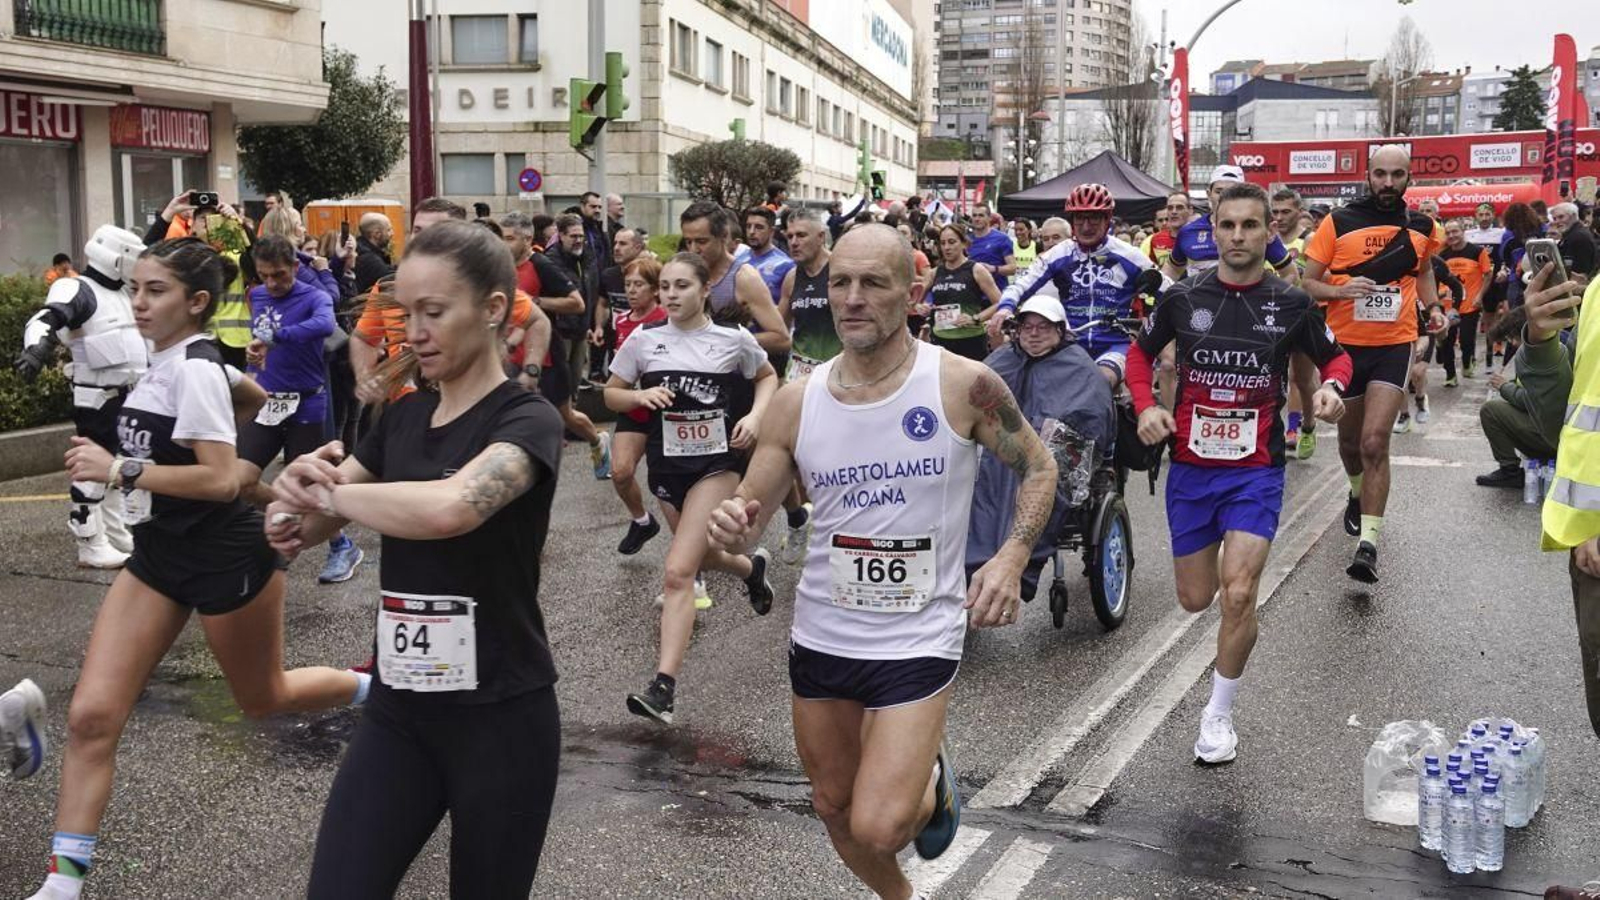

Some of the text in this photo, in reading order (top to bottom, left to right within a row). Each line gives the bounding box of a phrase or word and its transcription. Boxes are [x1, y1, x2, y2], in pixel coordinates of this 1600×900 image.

[141, 107, 210, 151] PELUQUERO
[1233, 155, 1265, 167] VIGO
[1340, 186, 1357, 195] 5+5
[1453, 192, 1514, 203] Santander
[1365, 295, 1393, 308] 299
[1193, 349, 1272, 374] GMTA &
[1189, 369, 1271, 389] CHUVONERS
[677, 424, 709, 439] 610
[1201, 422, 1240, 440] 848
[811, 457, 945, 488] SAMERTOLAMEU
[842, 484, 906, 509] MOAÑA
[853, 557, 907, 583] 166
[394, 622, 430, 655] 64
